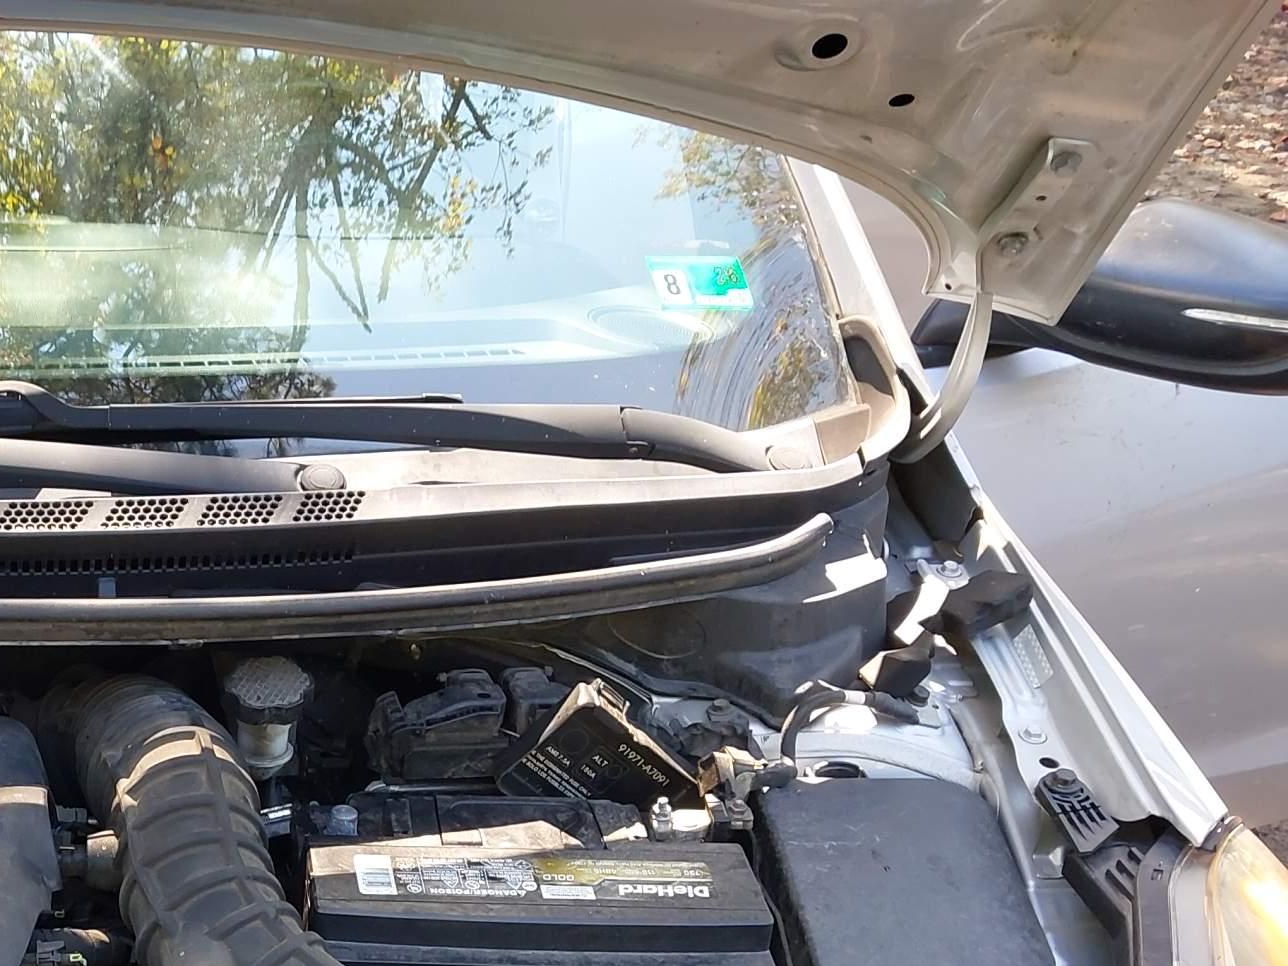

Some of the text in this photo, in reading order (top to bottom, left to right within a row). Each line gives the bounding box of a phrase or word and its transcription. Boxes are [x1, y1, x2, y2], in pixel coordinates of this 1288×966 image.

[663, 274, 681, 295] 8
[591, 754, 609, 768] ALT
[618, 743, 670, 787] 91971-A7091
[542, 873, 575, 882] GOLD
[618, 883, 710, 898] DieHard
